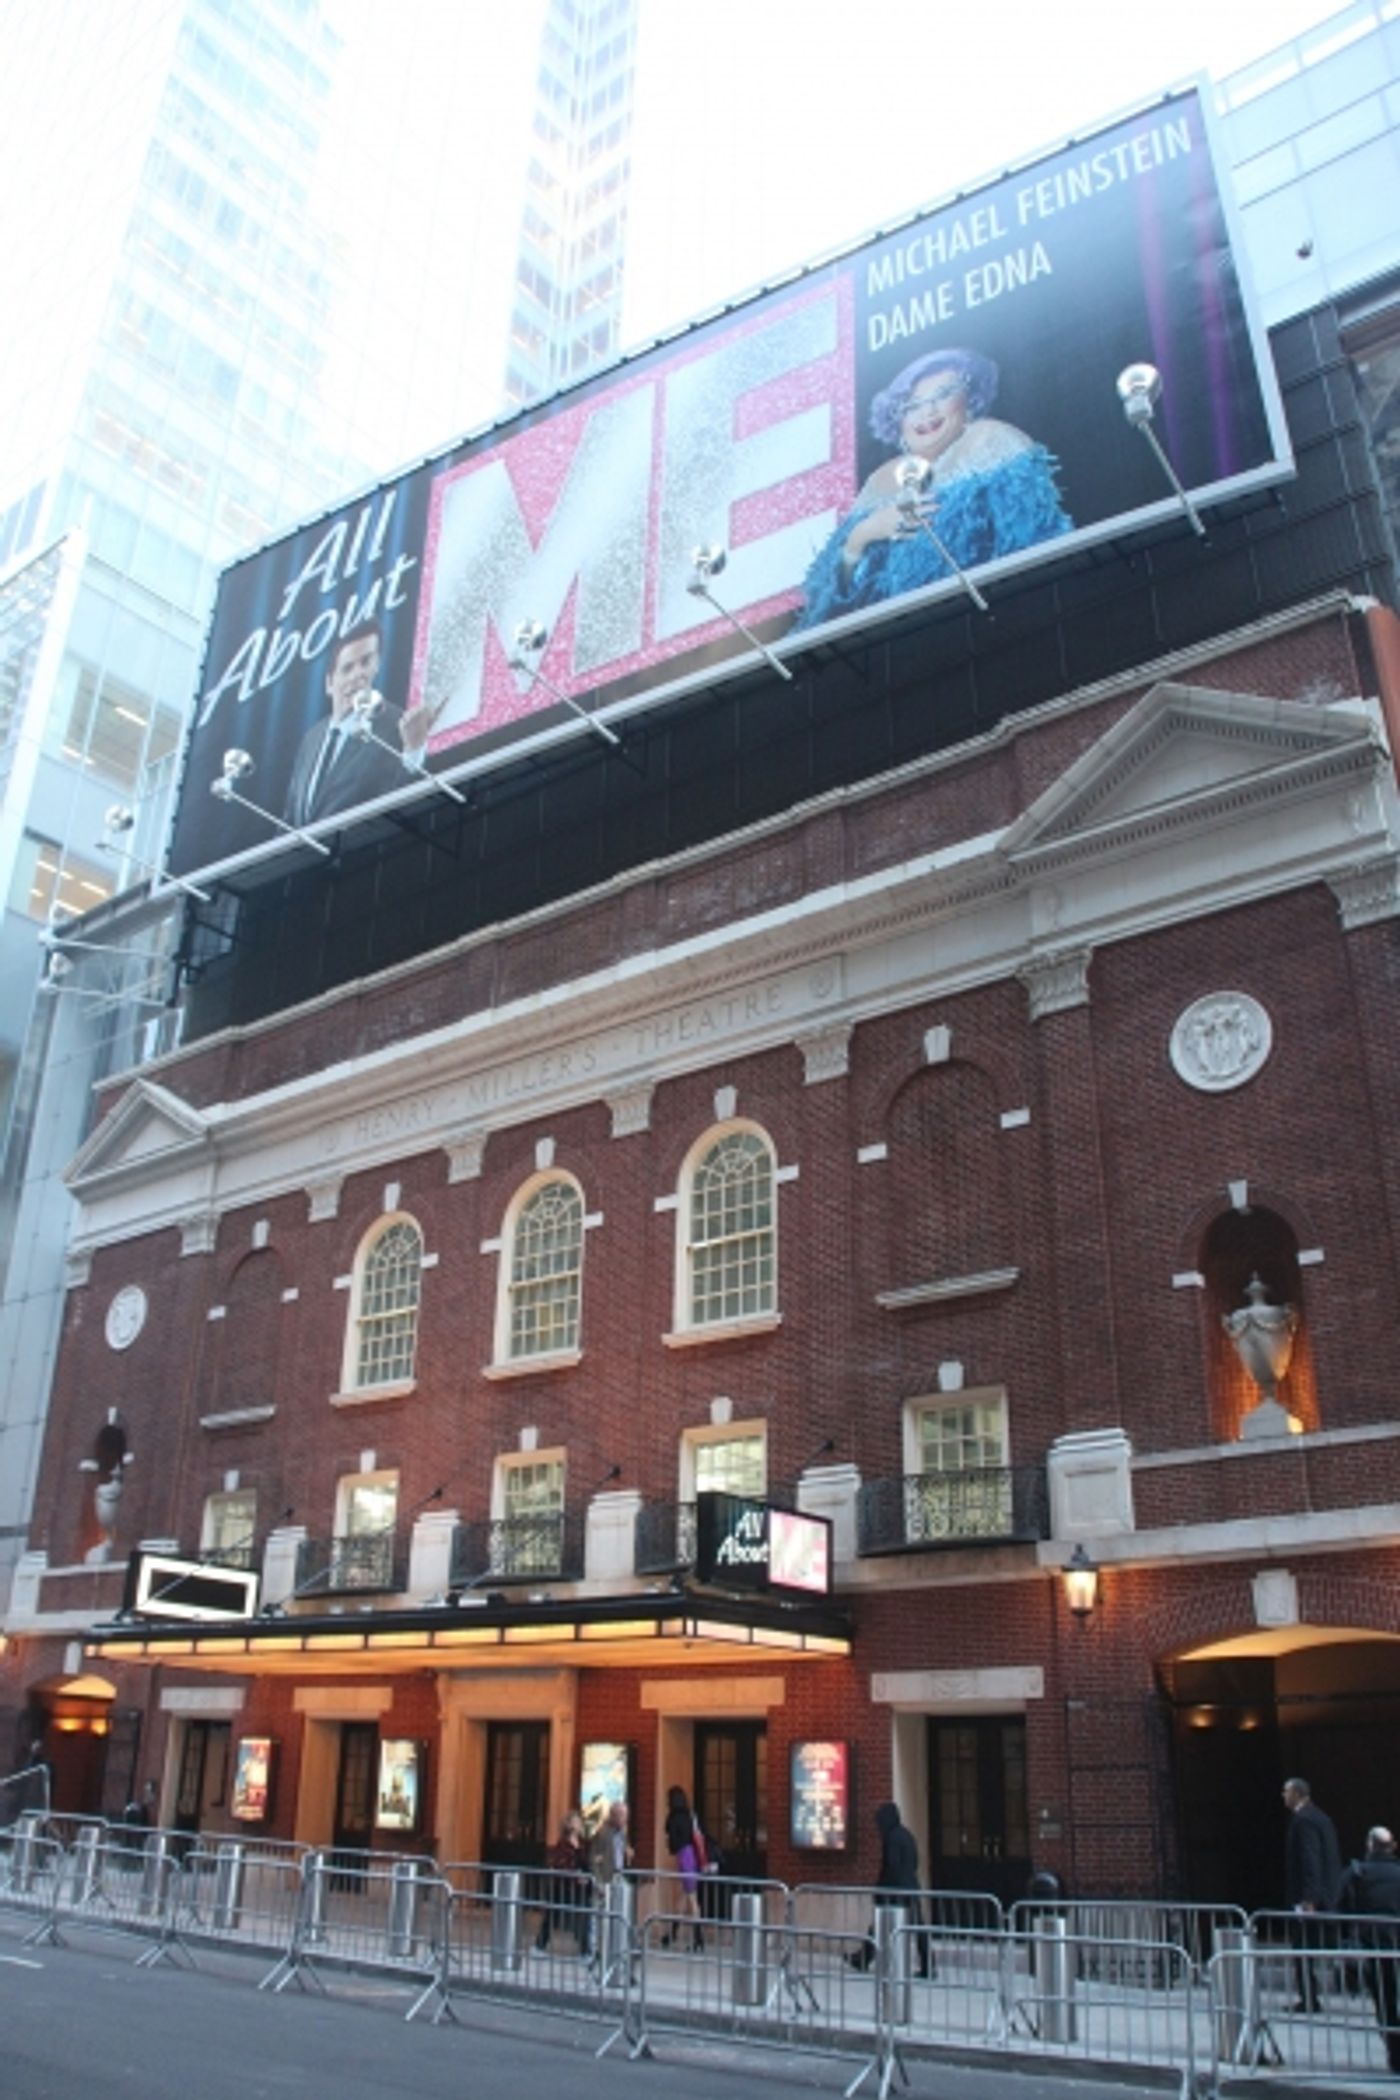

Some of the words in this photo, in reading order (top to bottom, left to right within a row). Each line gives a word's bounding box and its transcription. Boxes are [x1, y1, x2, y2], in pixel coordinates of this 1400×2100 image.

[866, 212, 1008, 297] MICHAEL
[1016, 116, 1192, 227] FEINSTEIN
[867, 280, 954, 352] DAME
[964, 240, 1052, 310] EDNA
[277, 489, 398, 619] All
[421, 293, 838, 736] ME
[200, 554, 417, 726] About
[359, 1098, 434, 1141] HENRY
[630, 983, 783, 1055] THEATRE
